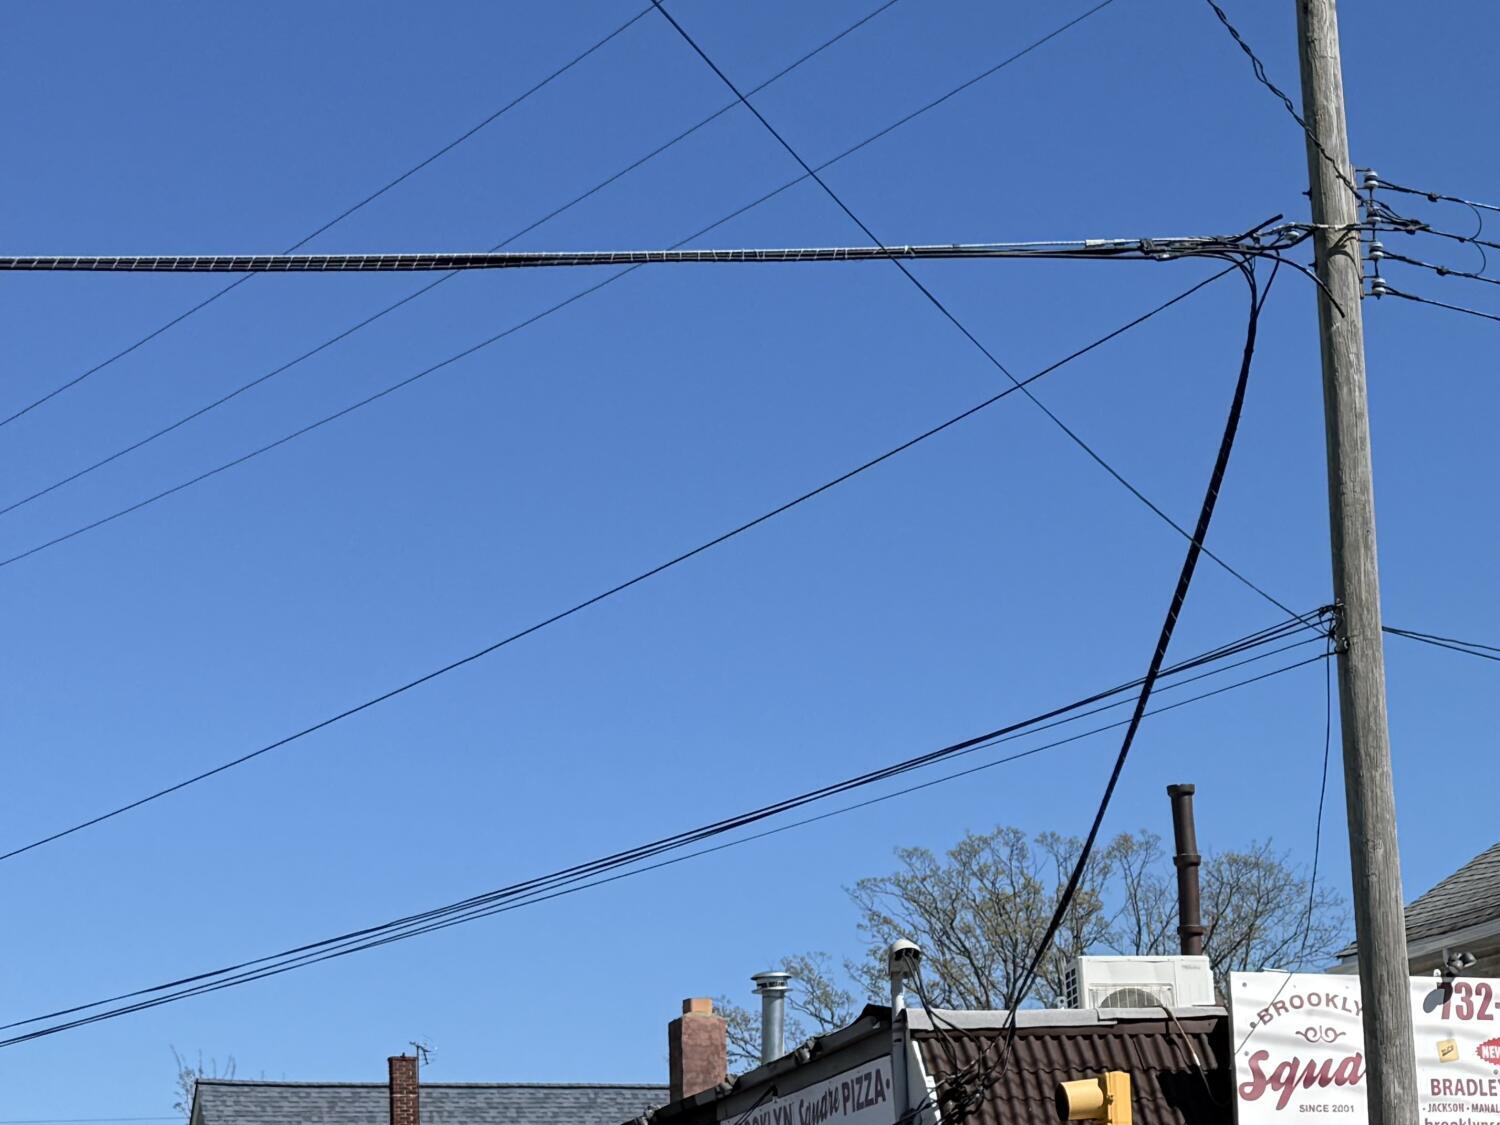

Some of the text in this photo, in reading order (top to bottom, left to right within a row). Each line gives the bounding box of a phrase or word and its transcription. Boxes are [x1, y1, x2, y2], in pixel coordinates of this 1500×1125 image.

[1256, 992, 1363, 1026] BROOKLY
[841, 1068, 887, 1116] PIZZA
[1238, 1049, 1367, 1111] Squa
[1299, 1104, 1355, 1113] SINCE 2001
[1427, 1103, 1465, 1113] JACKSON
